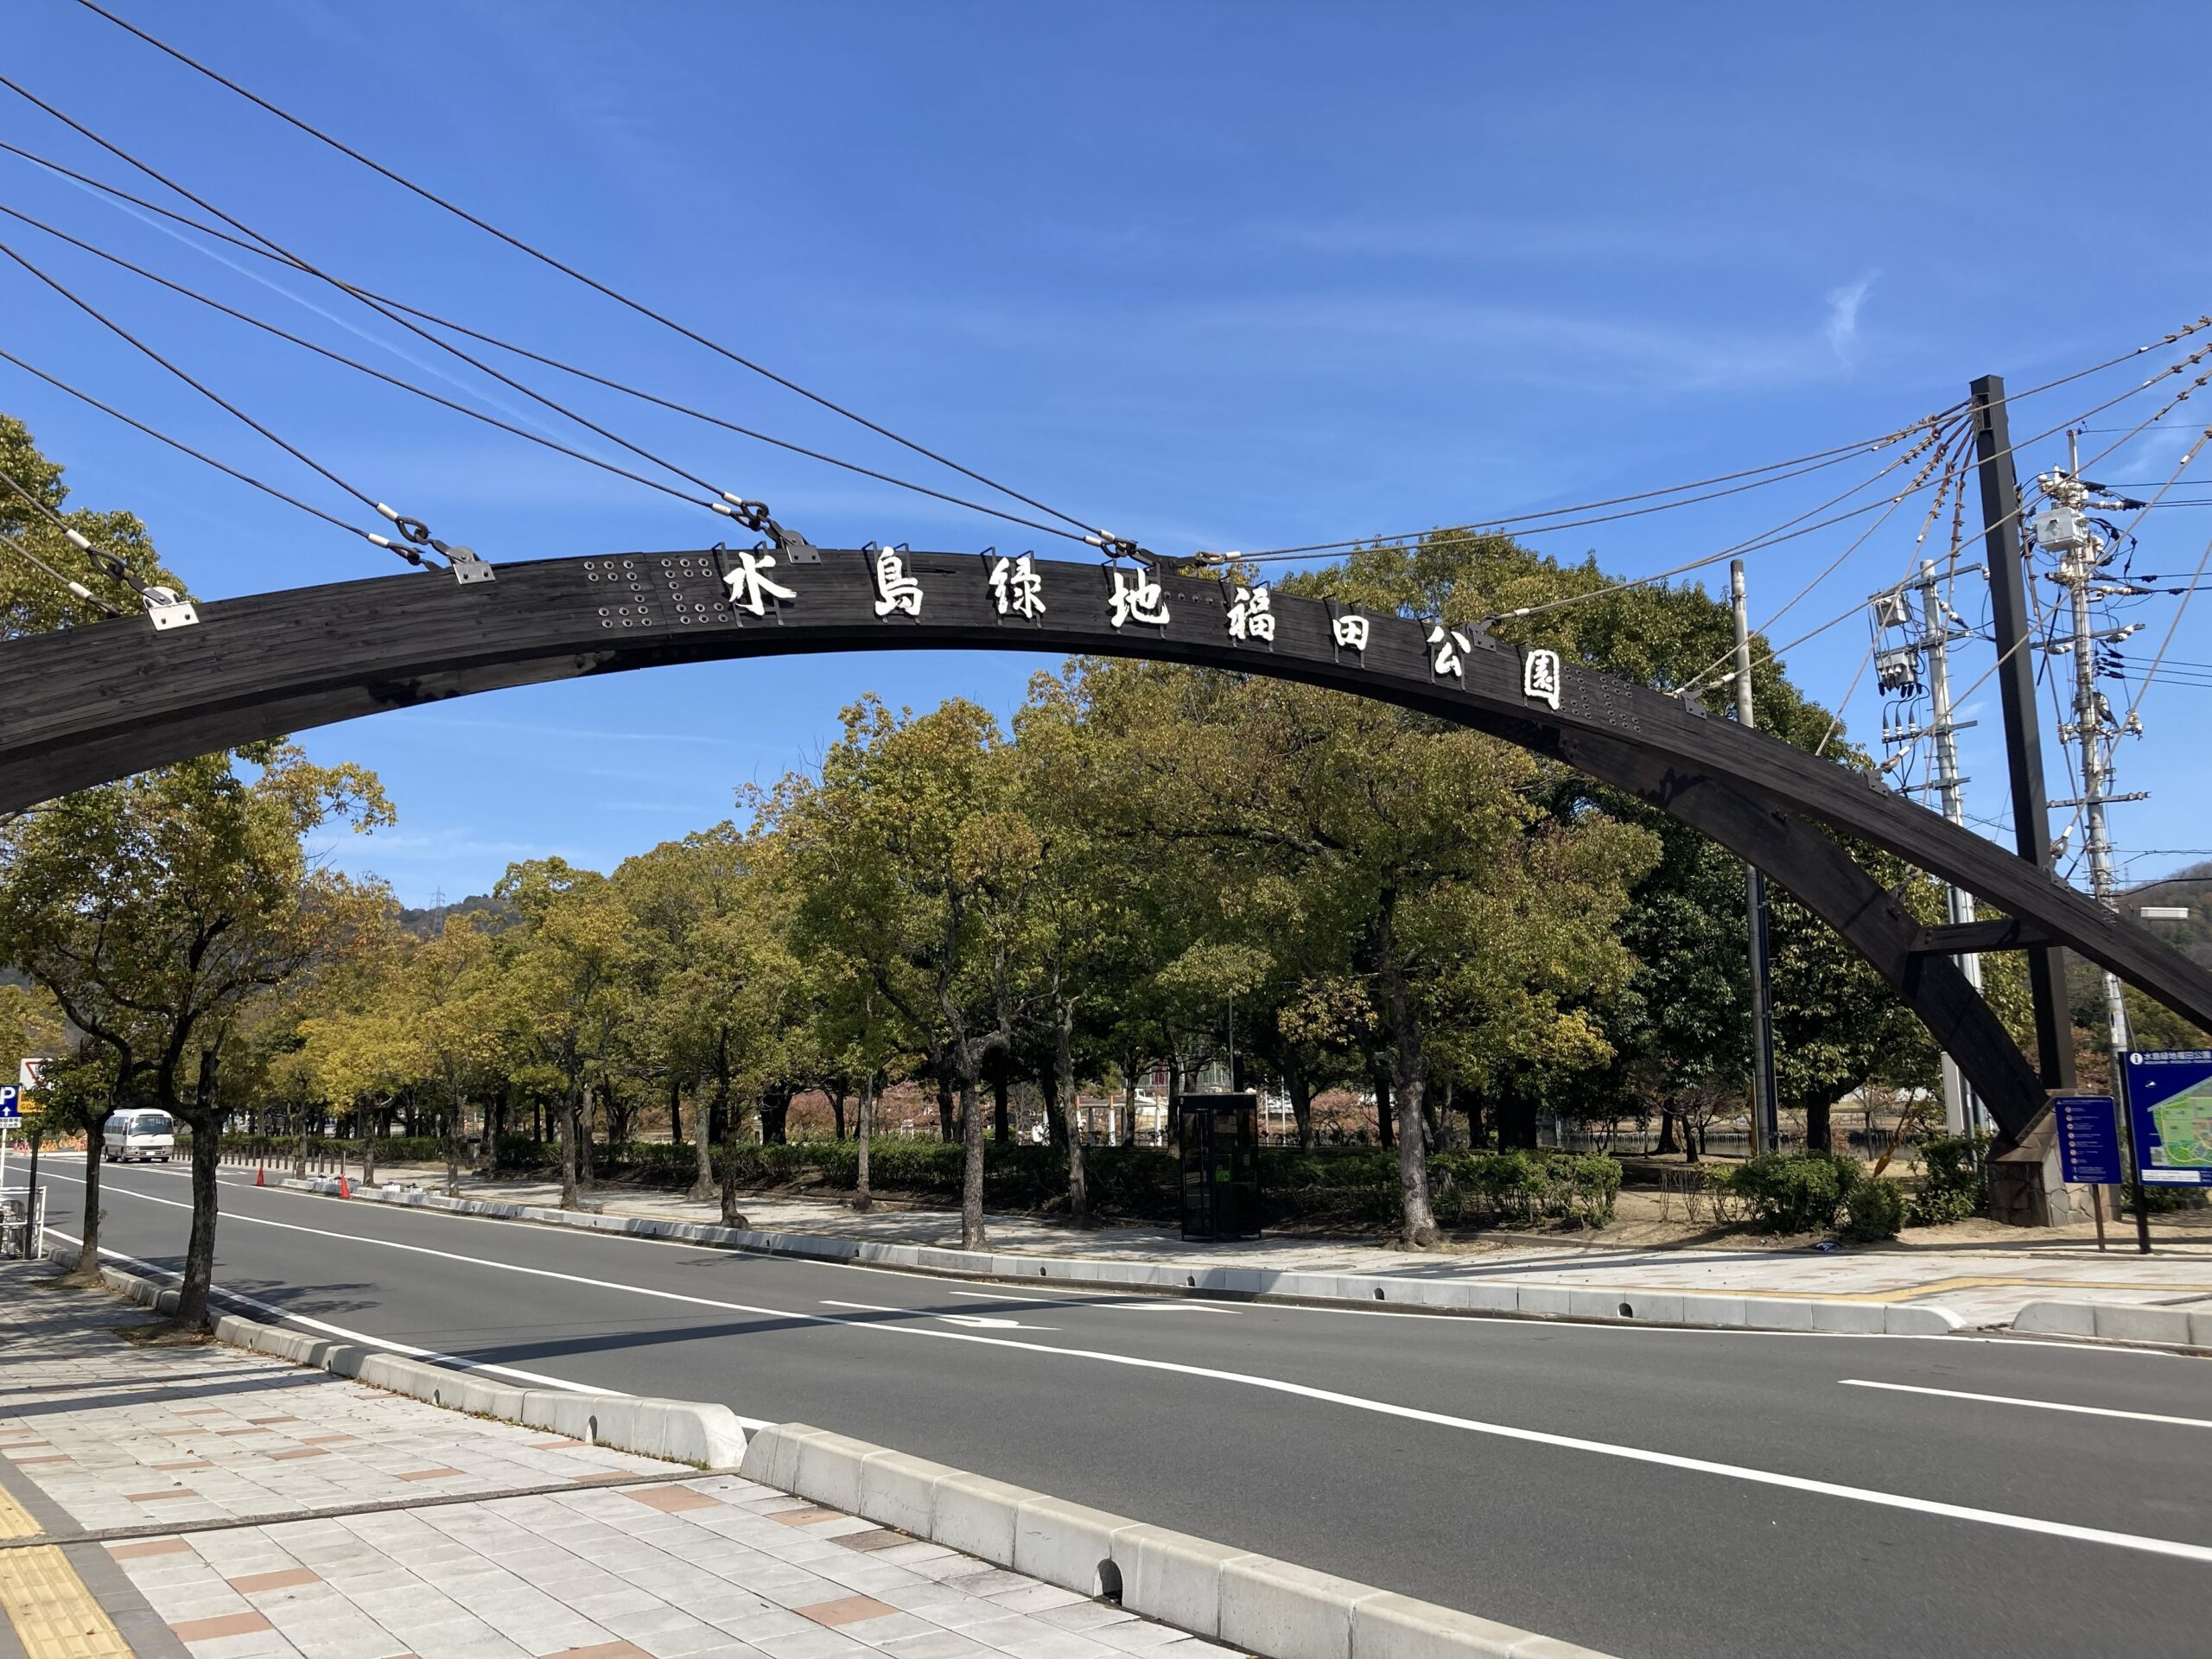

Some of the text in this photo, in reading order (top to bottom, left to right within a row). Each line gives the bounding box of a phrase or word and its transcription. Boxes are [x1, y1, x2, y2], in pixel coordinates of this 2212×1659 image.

[724, 546, 1560, 710] 水島緑地福田公園
[0, 1087, 16, 1105] P
